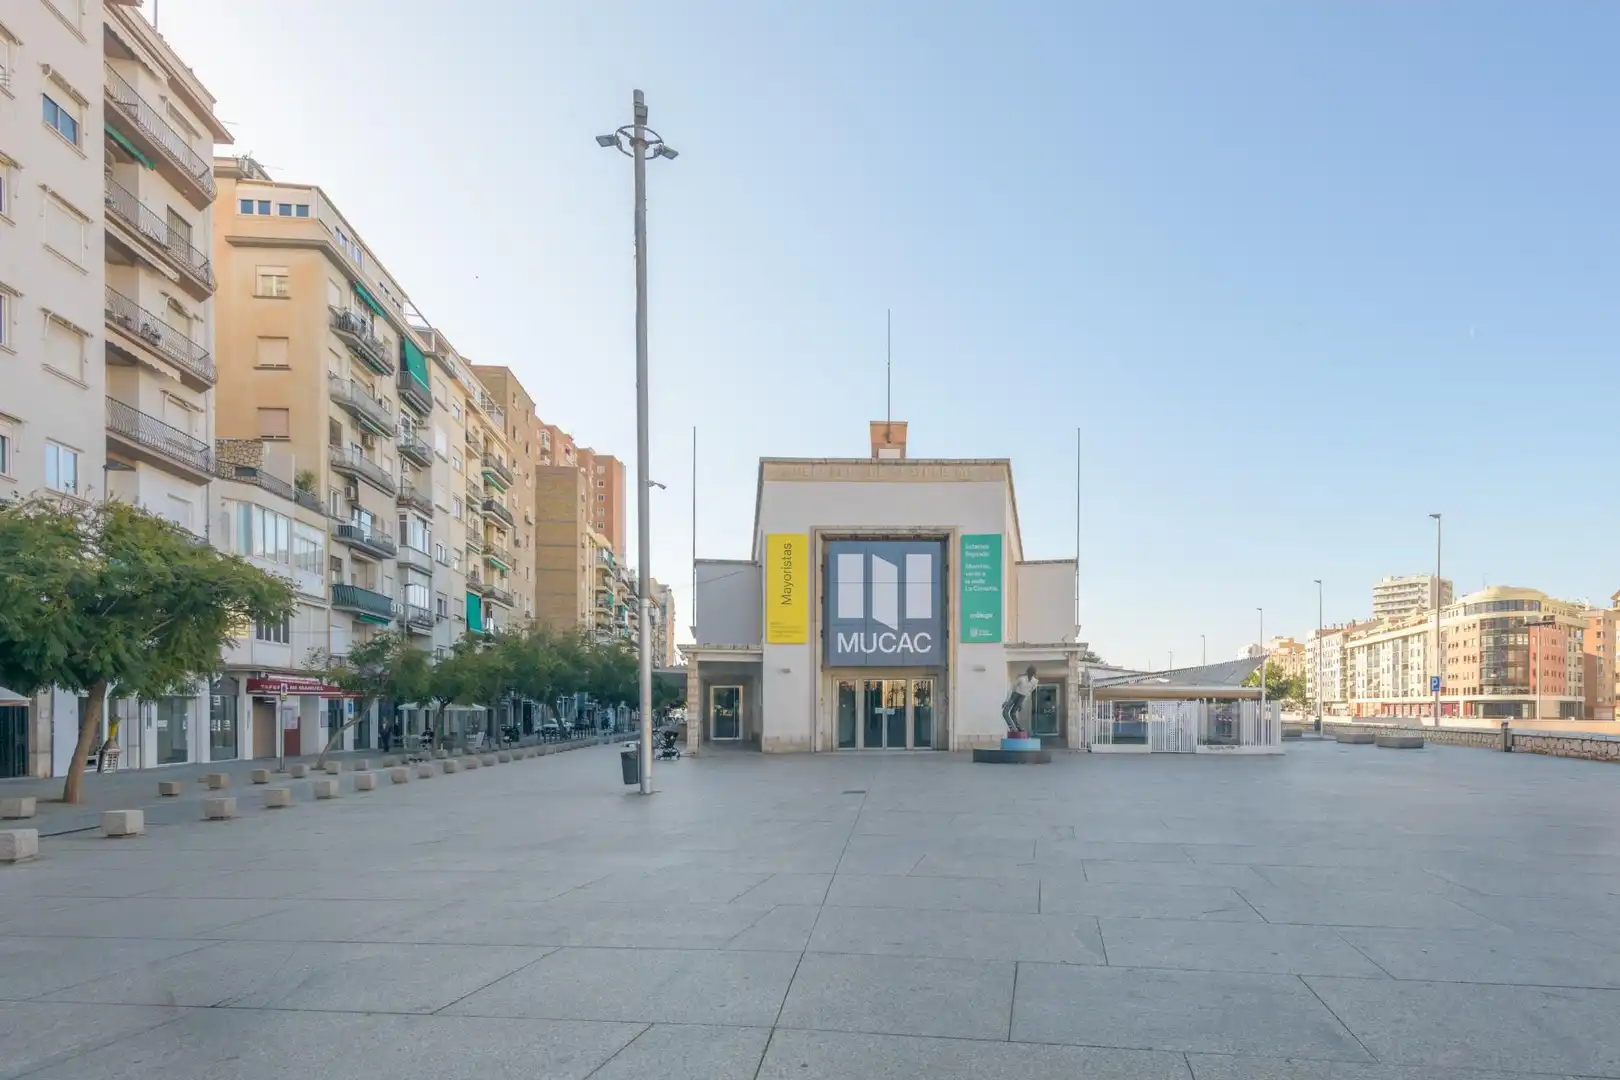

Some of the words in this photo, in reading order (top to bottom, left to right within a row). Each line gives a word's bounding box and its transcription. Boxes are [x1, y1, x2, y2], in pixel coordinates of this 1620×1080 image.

[781, 543, 795, 605] Mayoristas
[837, 632, 932, 654] MUCAC
[1432, 677, 1438, 690] P
